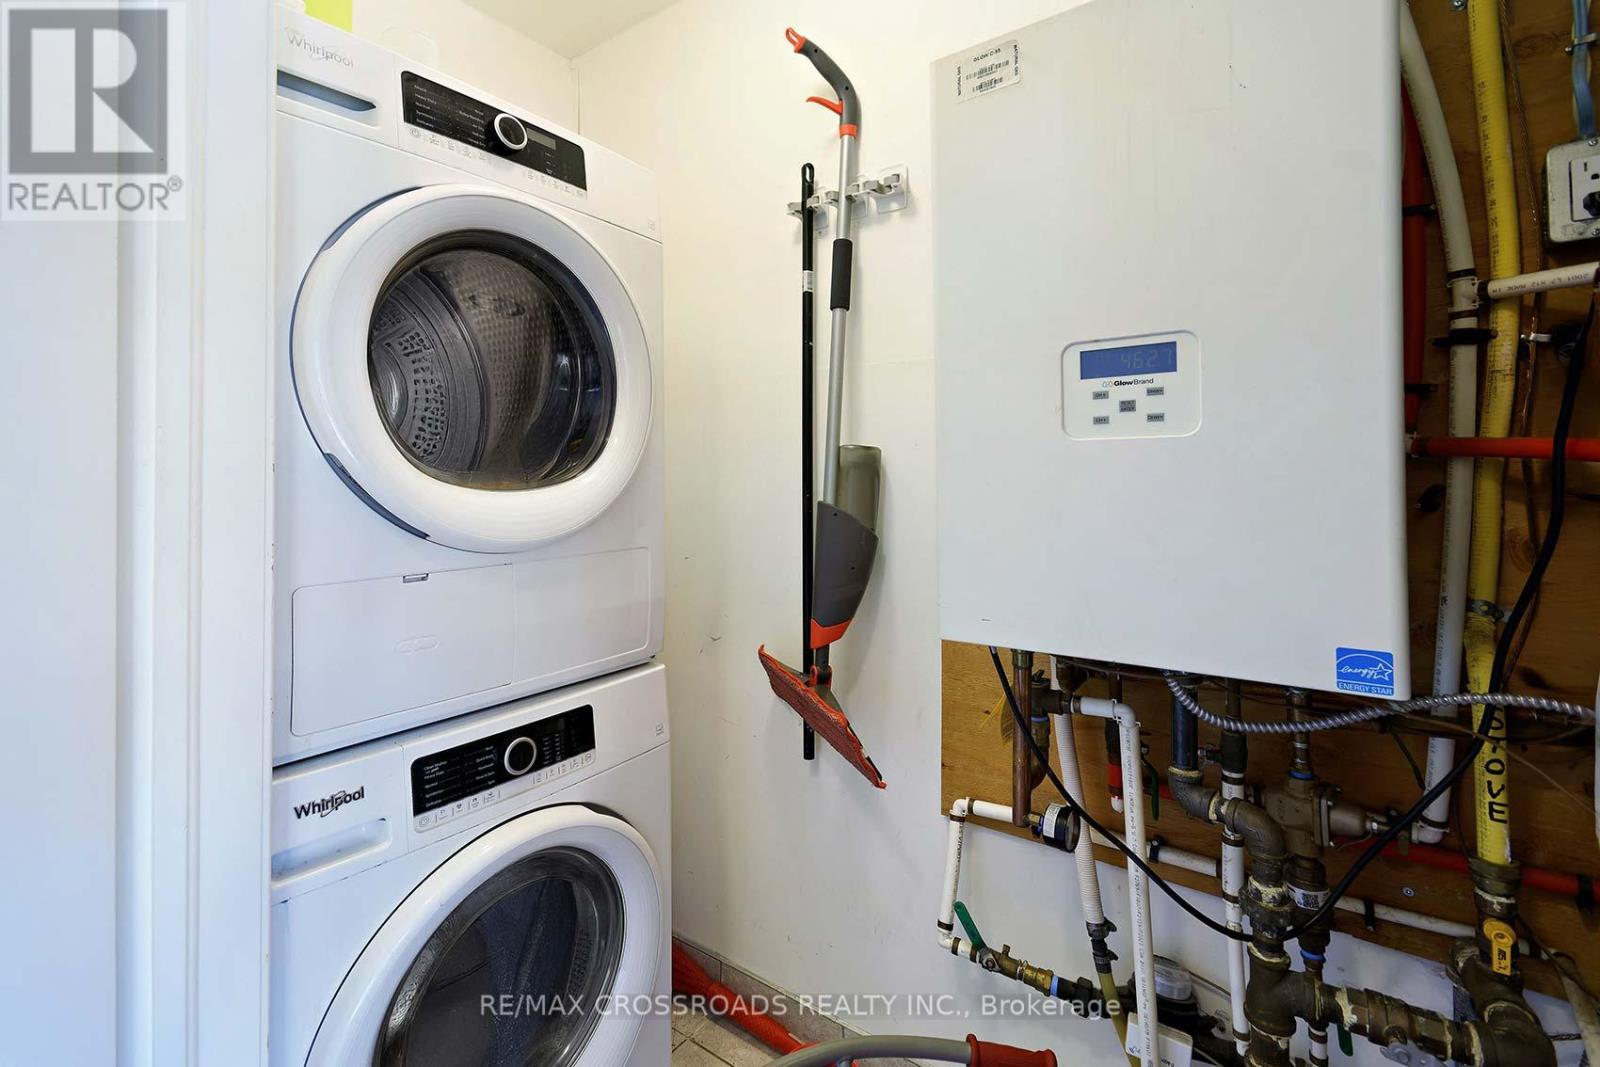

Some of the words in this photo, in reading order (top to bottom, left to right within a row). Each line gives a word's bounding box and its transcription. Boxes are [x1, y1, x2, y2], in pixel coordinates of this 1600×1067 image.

[287, 31, 354, 68] Whirlpool
[1338, 682, 1370, 692] ENERGY
[1370, 686, 1393, 695] STAR
[293, 786, 365, 819] Whirlpool
